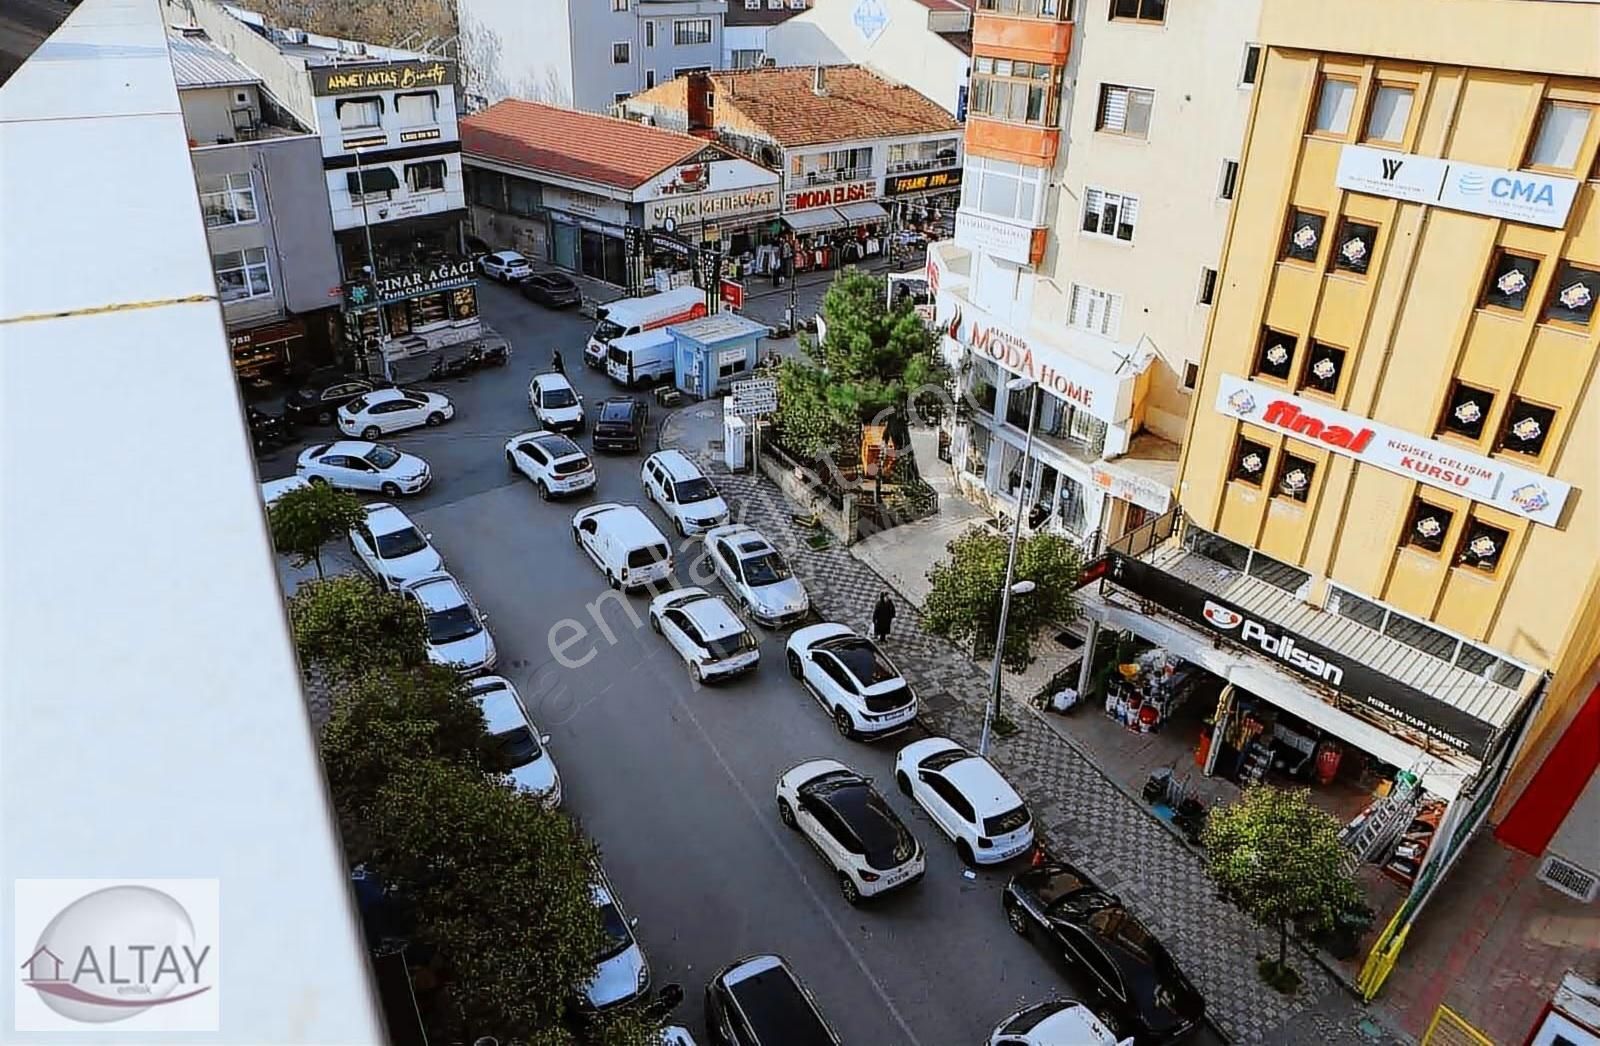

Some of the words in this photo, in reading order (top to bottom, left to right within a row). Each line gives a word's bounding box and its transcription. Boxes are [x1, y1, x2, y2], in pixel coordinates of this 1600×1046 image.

[328, 73, 363, 89] AHMET
[796, 188, 832, 209] MODA
[1491, 177, 1554, 206] CMA
[971, 320, 1035, 377] MODA
[1040, 364, 1093, 408] HOME
[1262, 400, 1376, 454] final
[1400, 456, 1470, 487] KURSU
[1241, 619, 1344, 687] Polisan
